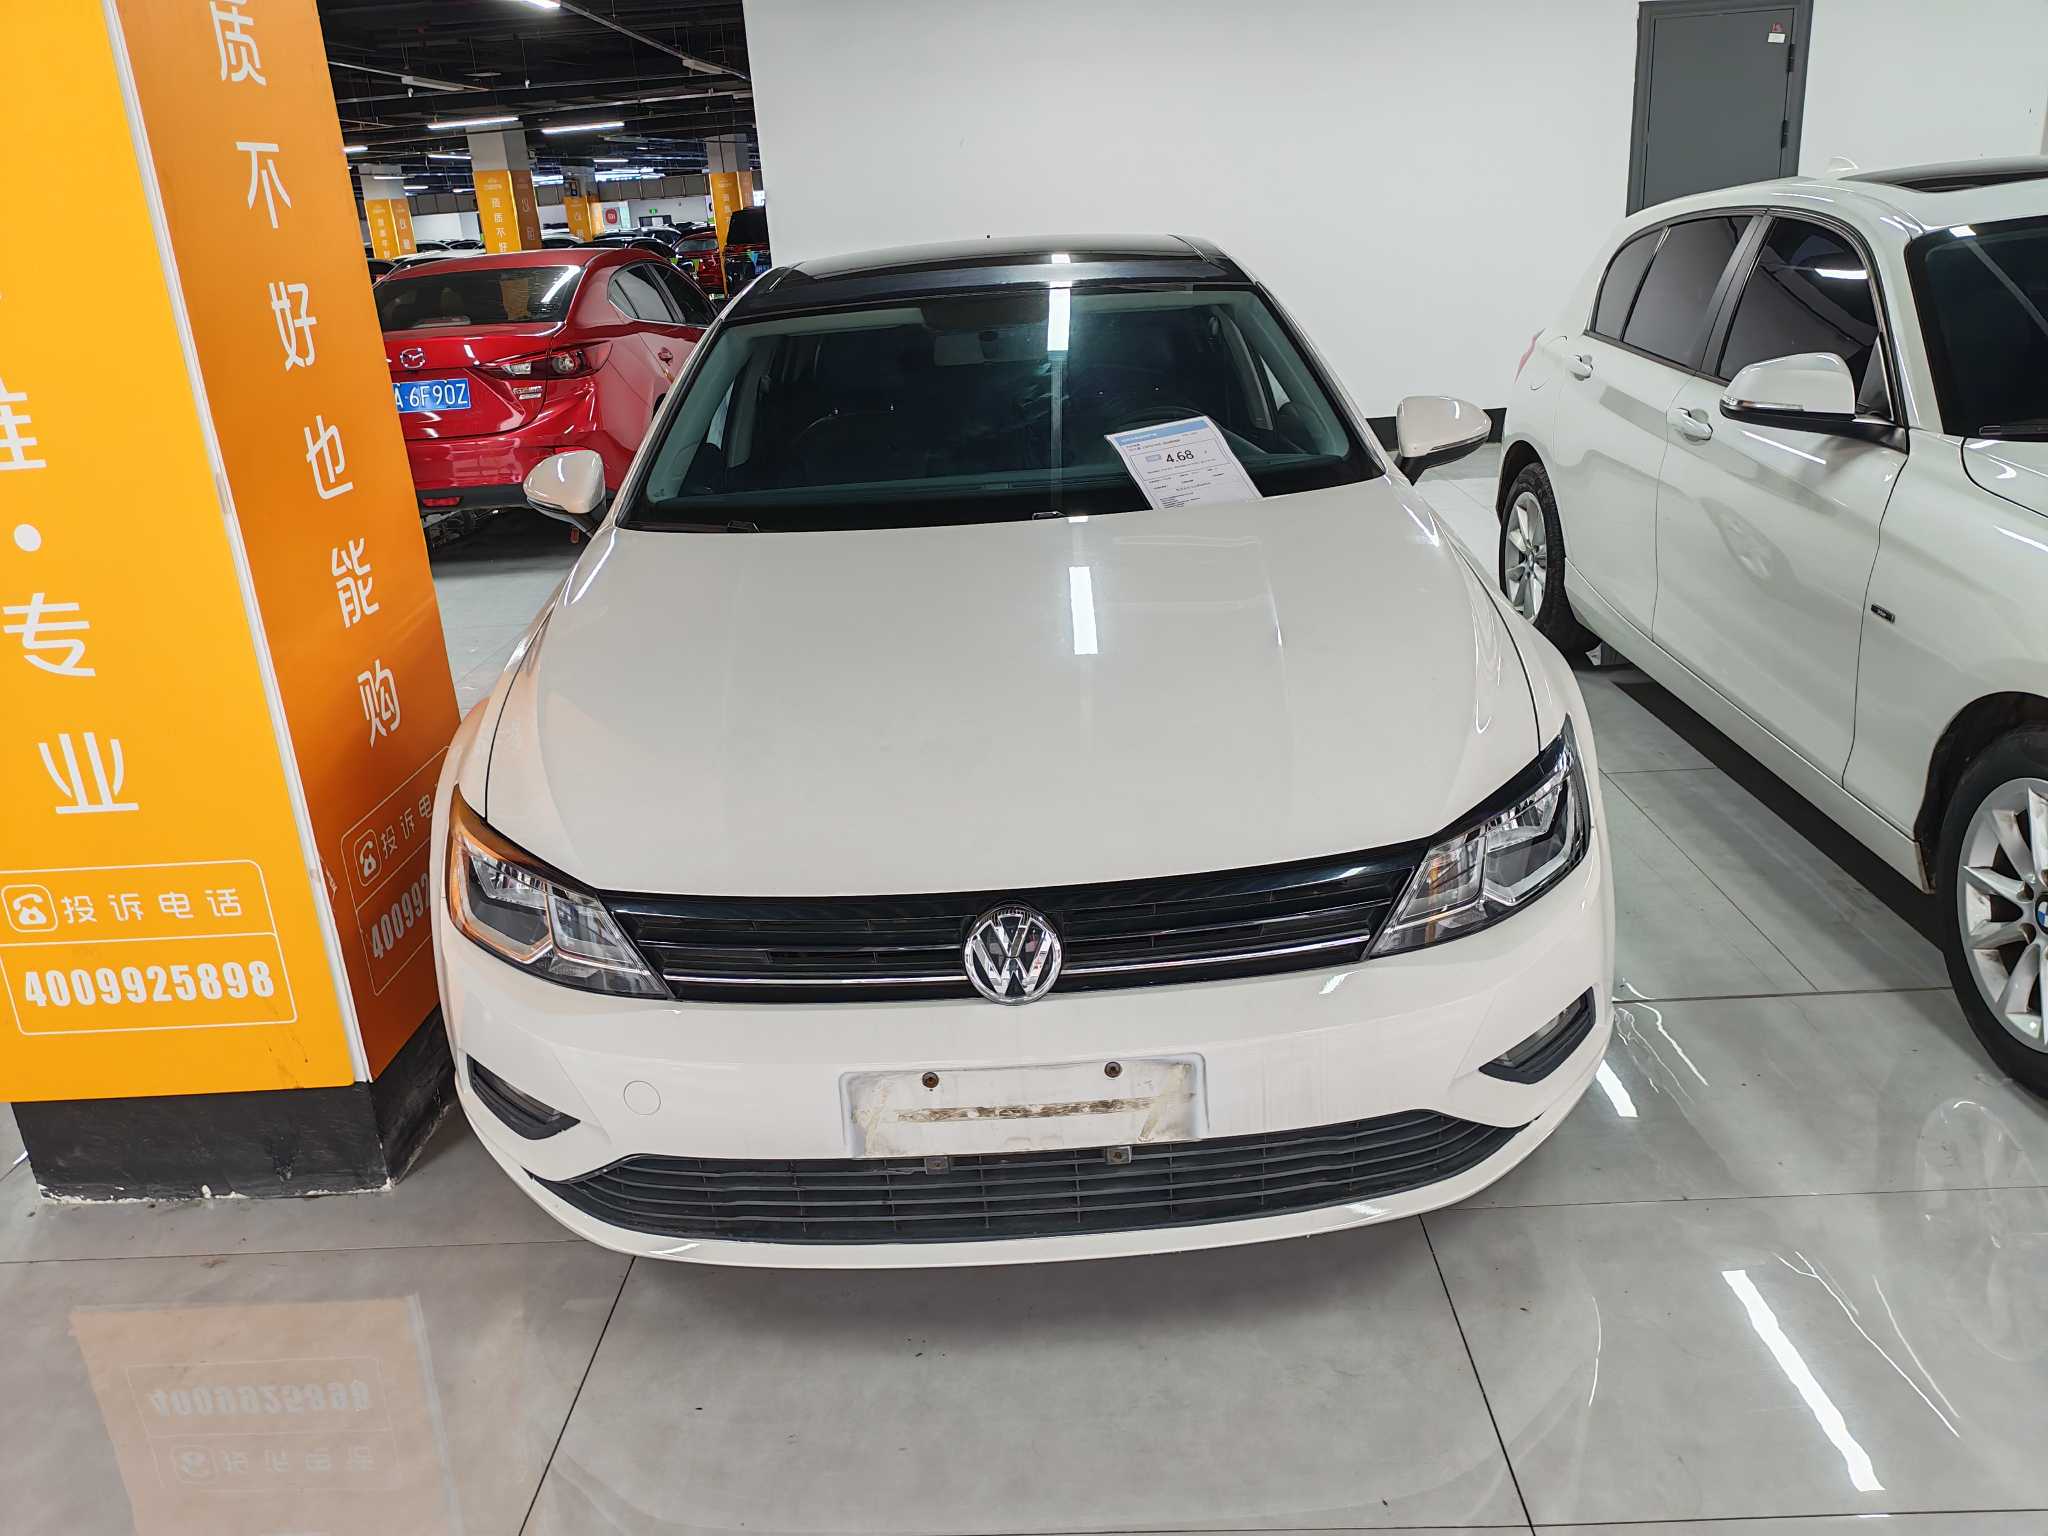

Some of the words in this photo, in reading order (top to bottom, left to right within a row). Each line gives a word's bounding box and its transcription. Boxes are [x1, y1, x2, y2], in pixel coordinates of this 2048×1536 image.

[1166, 449, 1195, 463] 4.68
[381, 783, 437, 859] 投诉电
[61, 888, 243, 924] 投诉电话
[24, 960, 275, 1008] 4009925898
